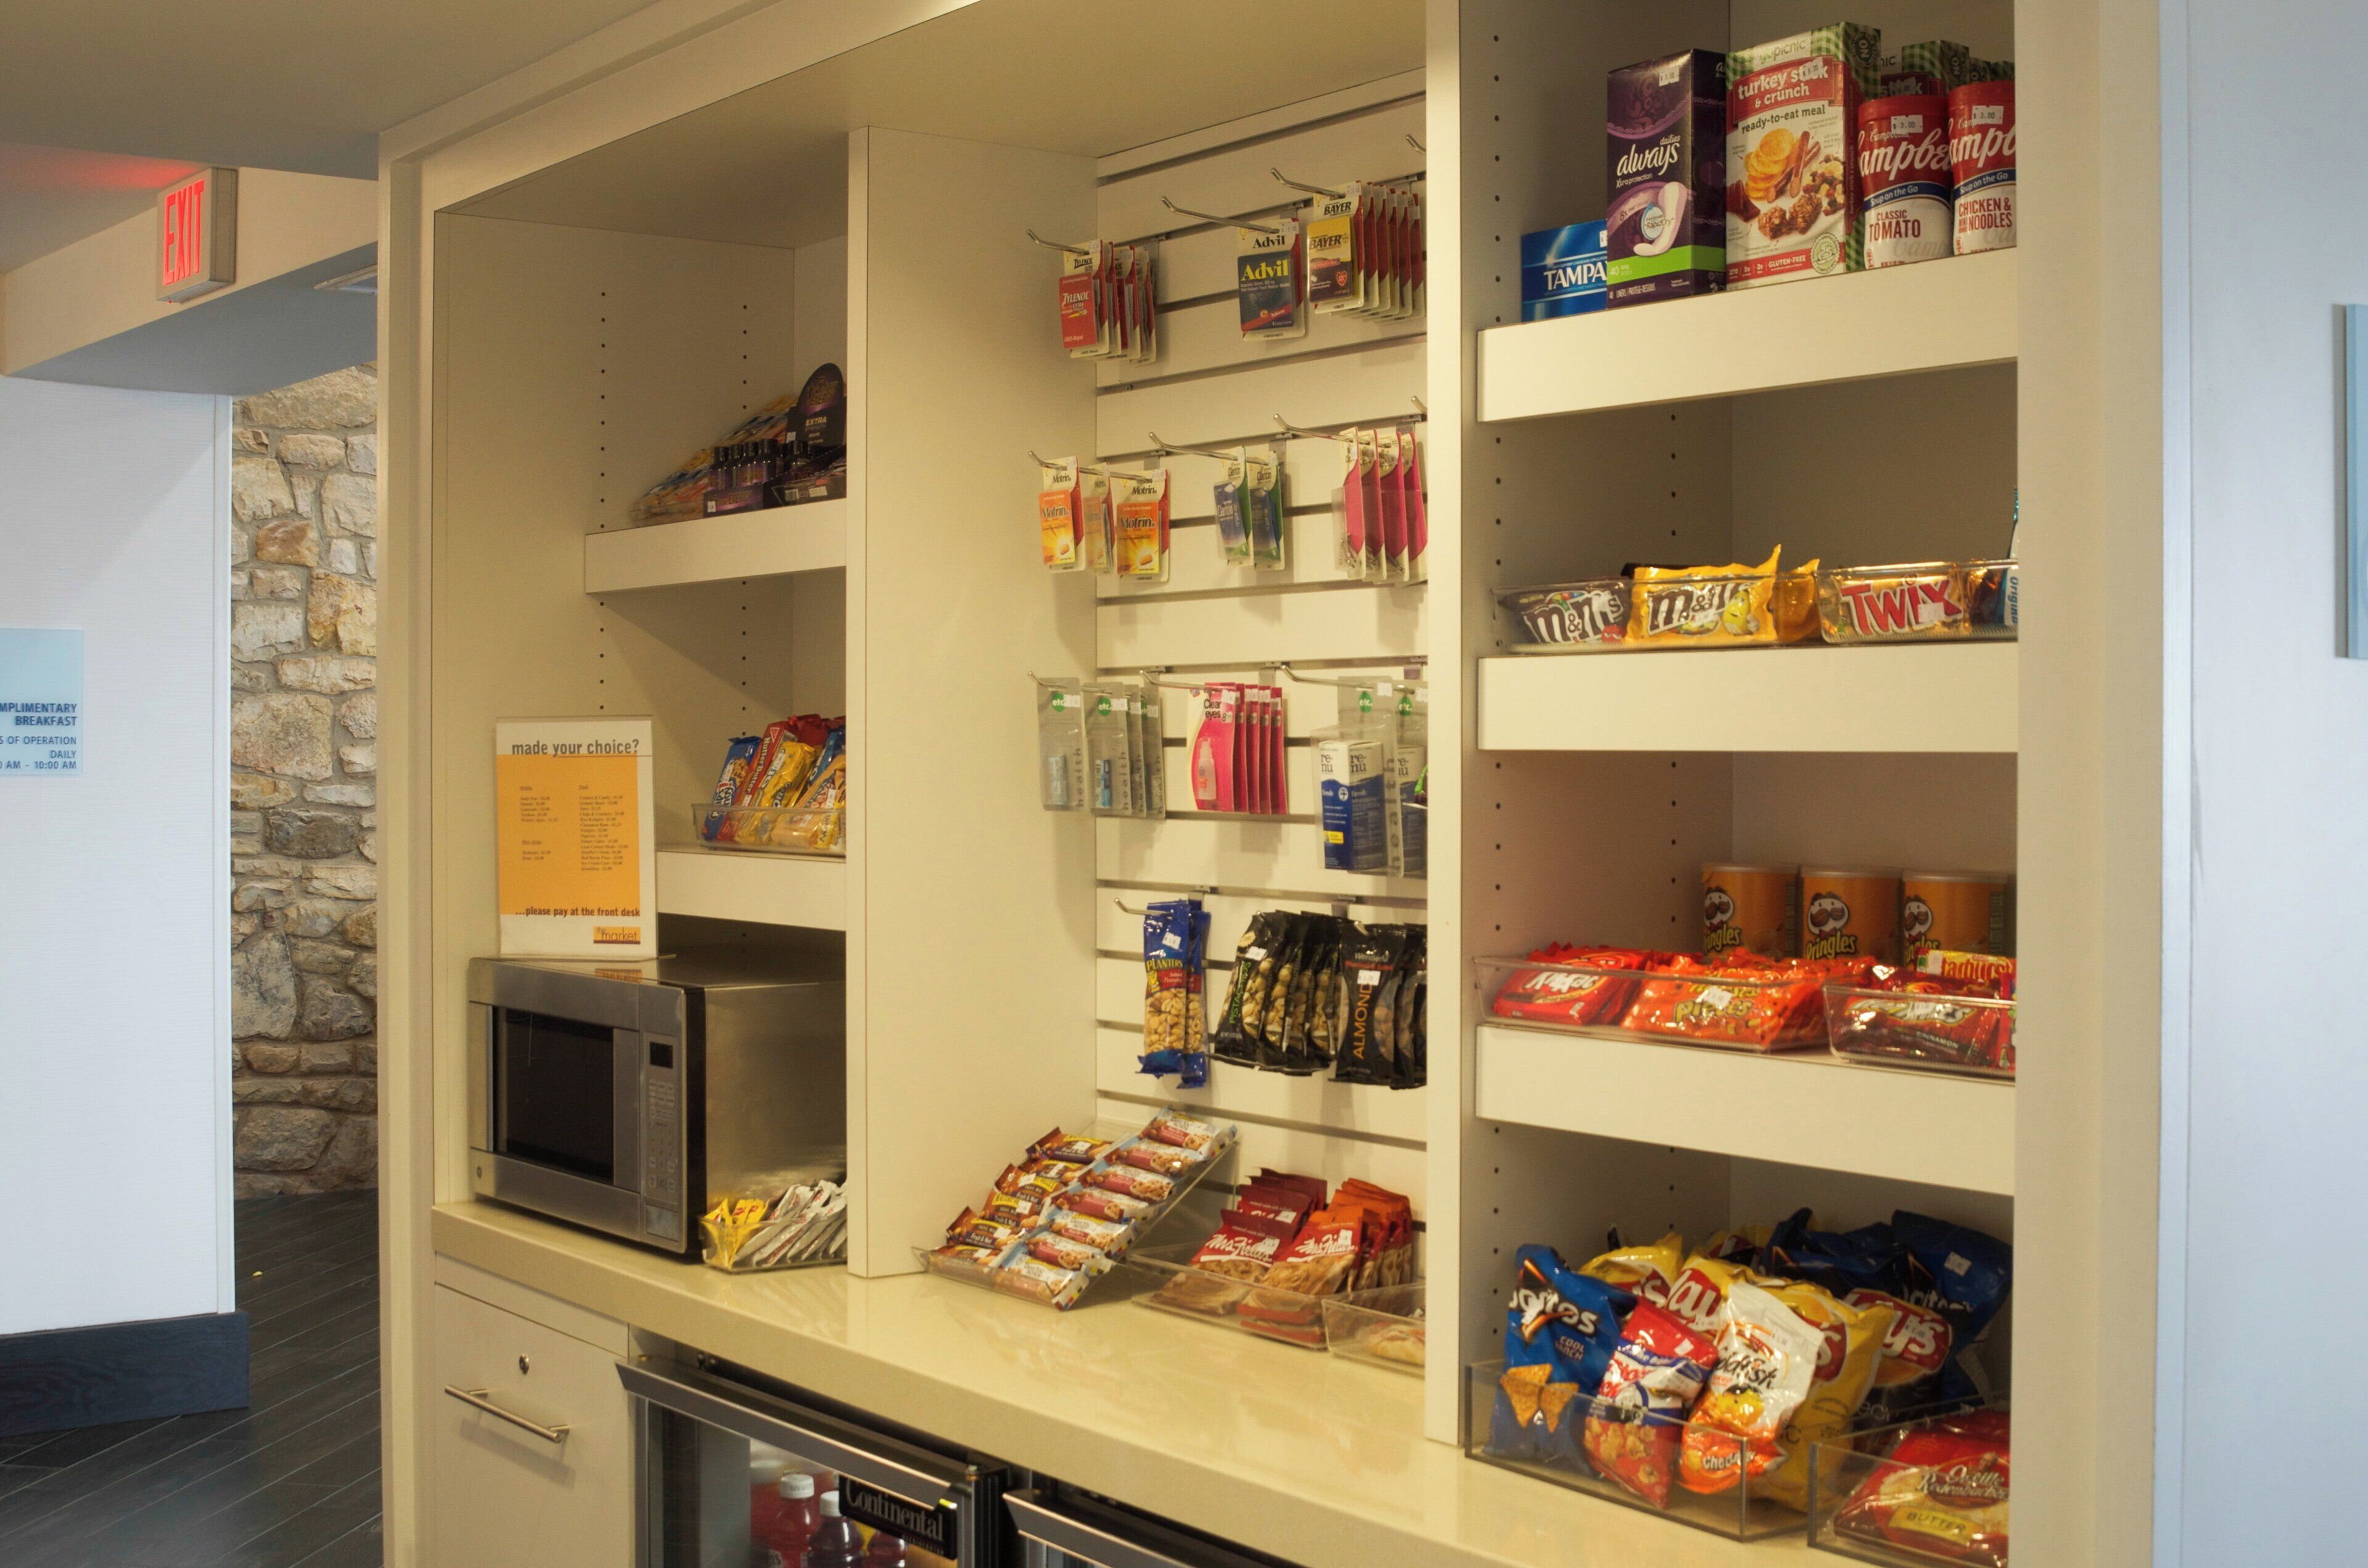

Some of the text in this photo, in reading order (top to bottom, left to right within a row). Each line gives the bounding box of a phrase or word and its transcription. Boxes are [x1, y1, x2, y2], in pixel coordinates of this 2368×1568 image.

[1738, 71, 1787, 99] turkey
[1754, 83, 1810, 108] & crunch
[1742, 109, 1799, 134] ready-to-eat
[1802, 104, 1825, 117] meal
[1660, 134, 1680, 145] dailies
[1616, 142, 1680, 176] always
[1959, 184, 1972, 194] Soup
[1983, 175, 1996, 184] the
[1997, 172, 2008, 181] Go
[1870, 195, 1884, 207] Soup
[1907, 185, 1918, 193] Go
[1324, 202, 1352, 215] BAYER
[1959, 197, 2011, 216] CHICKEN &
[1877, 210, 1907, 222] CLASSIC
[1968, 213, 2012, 231] NOODLES
[163, 179, 204, 286] EXIT
[1869, 219, 1921, 242] TOMATO
[1253, 236, 1286, 248] Advil
[1310, 235, 1342, 250] BAYER
[1074, 257, 1093, 269] TYLENOL
[1768, 255, 1806, 268] GLUTEN-FREE
[1241, 259, 1289, 281] Advil
[1544, 261, 1607, 290] TAMPA
[1610, 266, 1619, 276] 40
[1063, 291, 1089, 306] TYLENOL
[805, 416, 827, 427] EXTRA
[1053, 473, 1069, 483] Motrin
[1132, 485, 1154, 495] Motrin
[1042, 505, 1067, 517] Motrin
[1119, 515, 1153, 528] Motrin
[1204, 699, 1222, 710] Clear
[15, 716, 77, 726] BREAKFAST
[1206, 710, 1222, 720] eyes
[8, 736, 20, 745] OF
[24, 736, 76, 745] OPERATION
[51, 750, 76, 758] DAILY
[512, 739, 639, 758] made your choice?
[7, 761, 21, 769] AM
[35, 761, 59, 770] 10:00
[63, 761, 77, 769] AM
[554, 908, 568, 917] pay
[570, 907, 578, 915] at
[582, 907, 594, 916] the
[598, 907, 618, 916] front
[621, 907, 640, 916] desk
[602, 927, 637, 942] market
[1146, 959, 1183, 971] PLANTERS
[1352, 982, 1373, 1060] ALMOND
[845, 1477, 944, 1541] Continental
[1907, 1511, 1967, 1533] BUTTER
